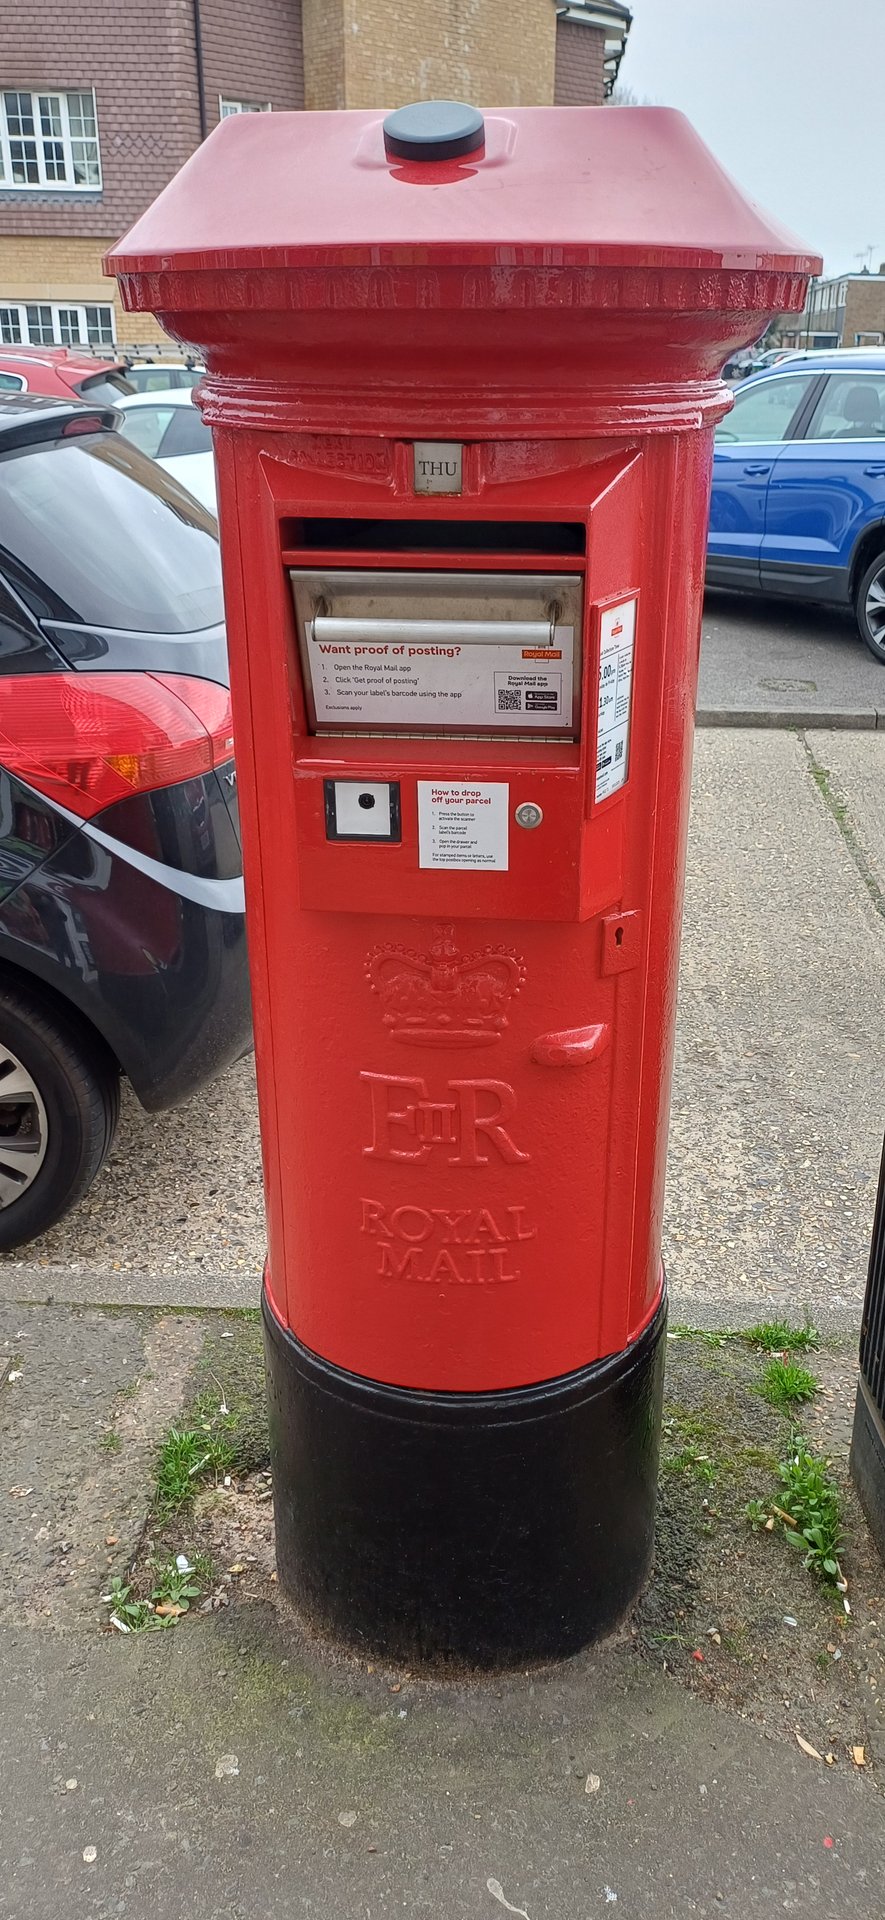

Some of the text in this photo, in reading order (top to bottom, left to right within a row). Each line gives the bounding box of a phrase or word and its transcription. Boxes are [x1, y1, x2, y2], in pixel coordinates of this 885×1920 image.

[419, 460, 457, 476] THU
[319, 644, 462, 658] Want proof of posting?
[334, 664, 351, 672] Open
[364, 664, 383, 672] Royal
[366, 677, 384, 685] proof
[360, 1197, 538, 1245] ROYAL
[376, 1241, 521, 1284] MAIL
